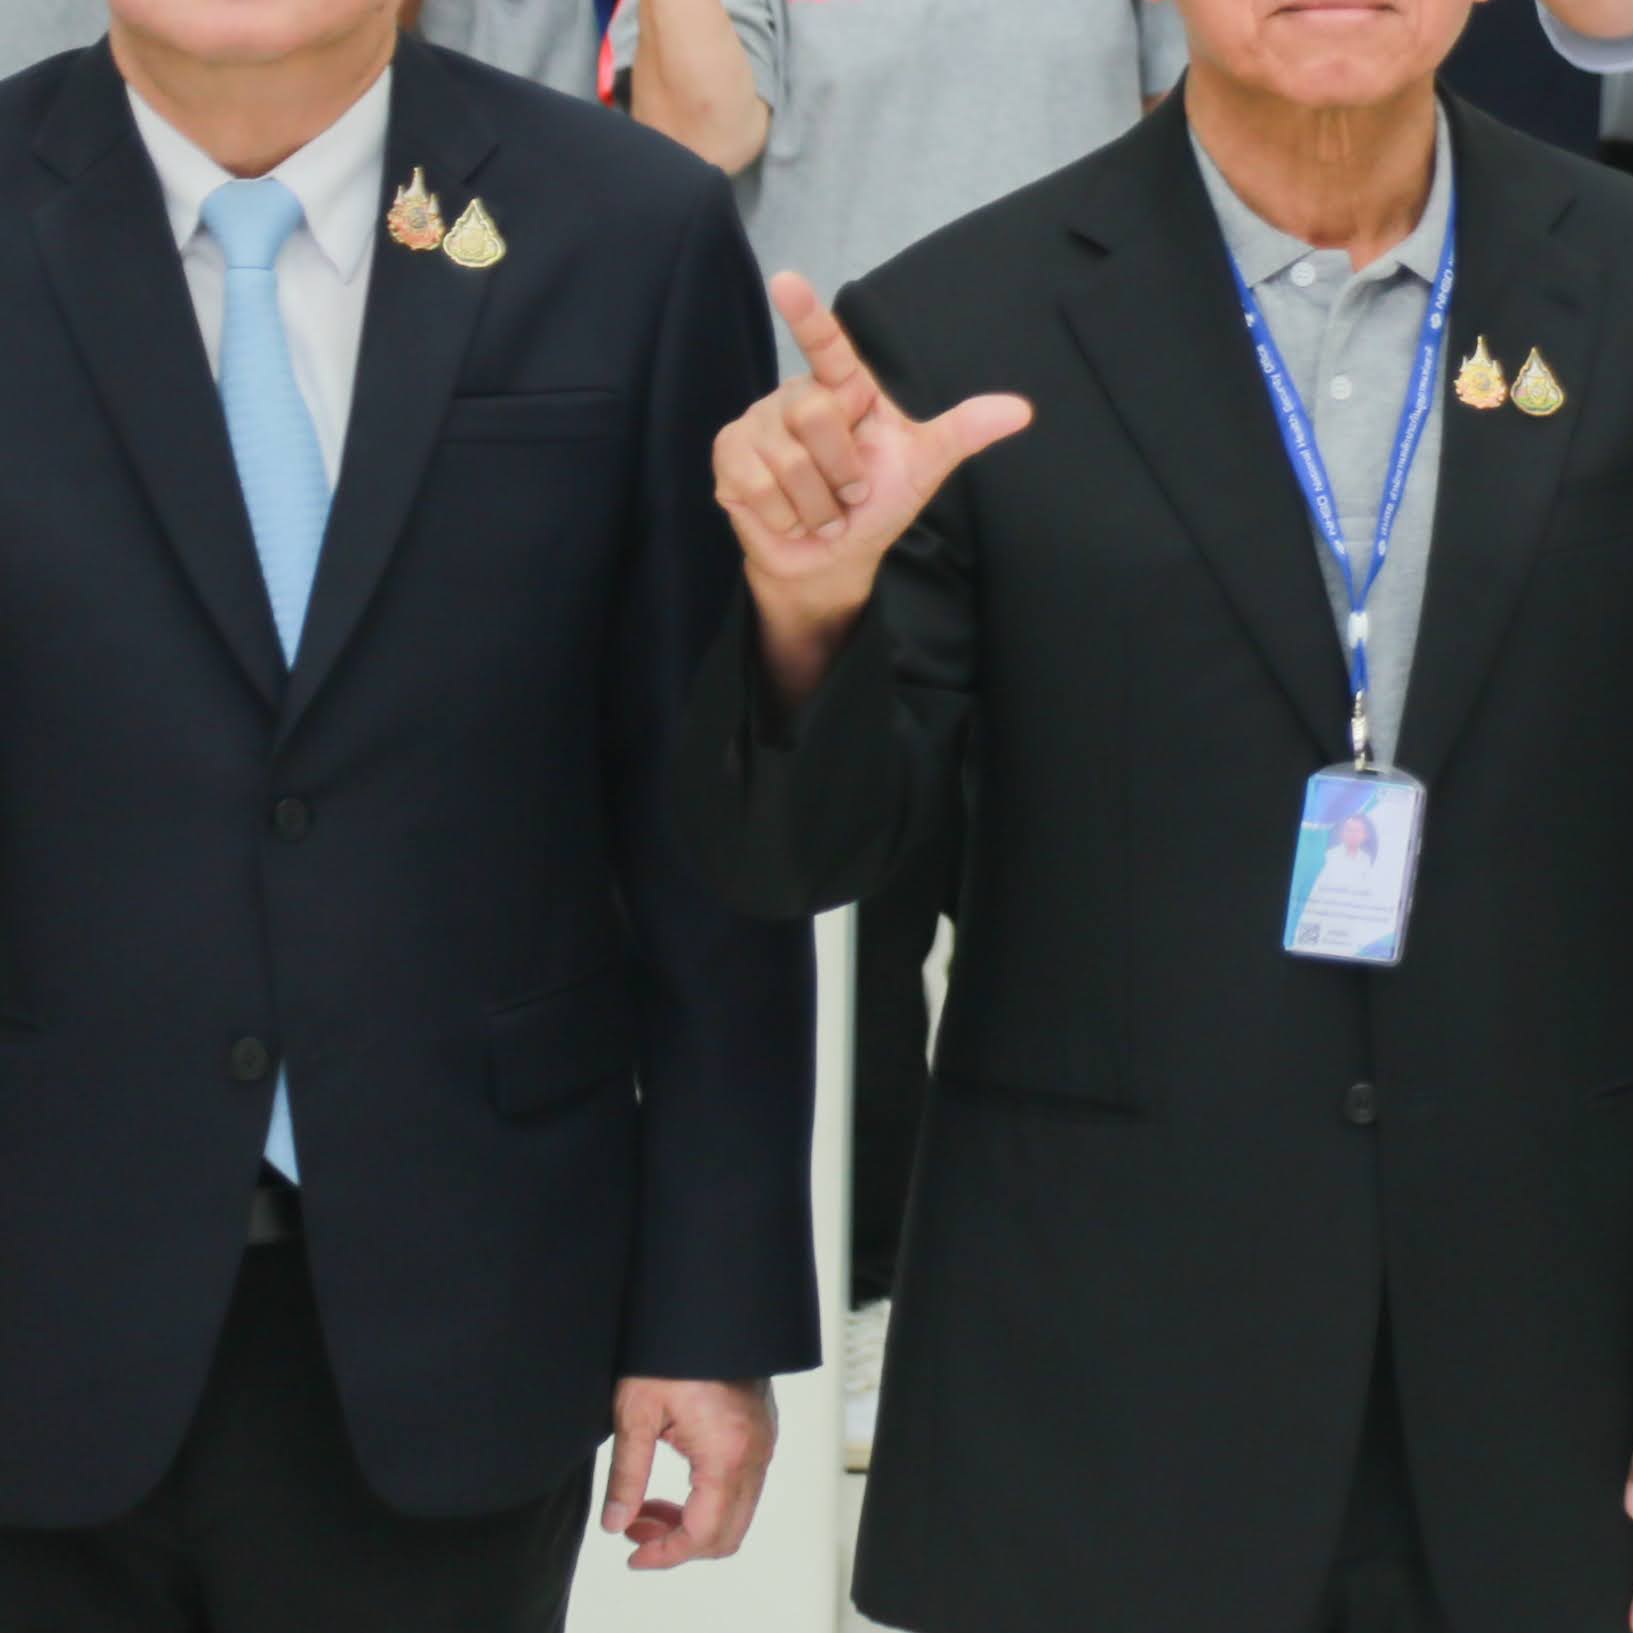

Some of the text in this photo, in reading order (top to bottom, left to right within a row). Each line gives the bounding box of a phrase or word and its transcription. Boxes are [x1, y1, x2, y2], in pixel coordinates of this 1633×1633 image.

[1256, 343, 1275, 374] Office
[1270, 373, 1294, 414] Security
[1287, 412, 1306, 448] Health
